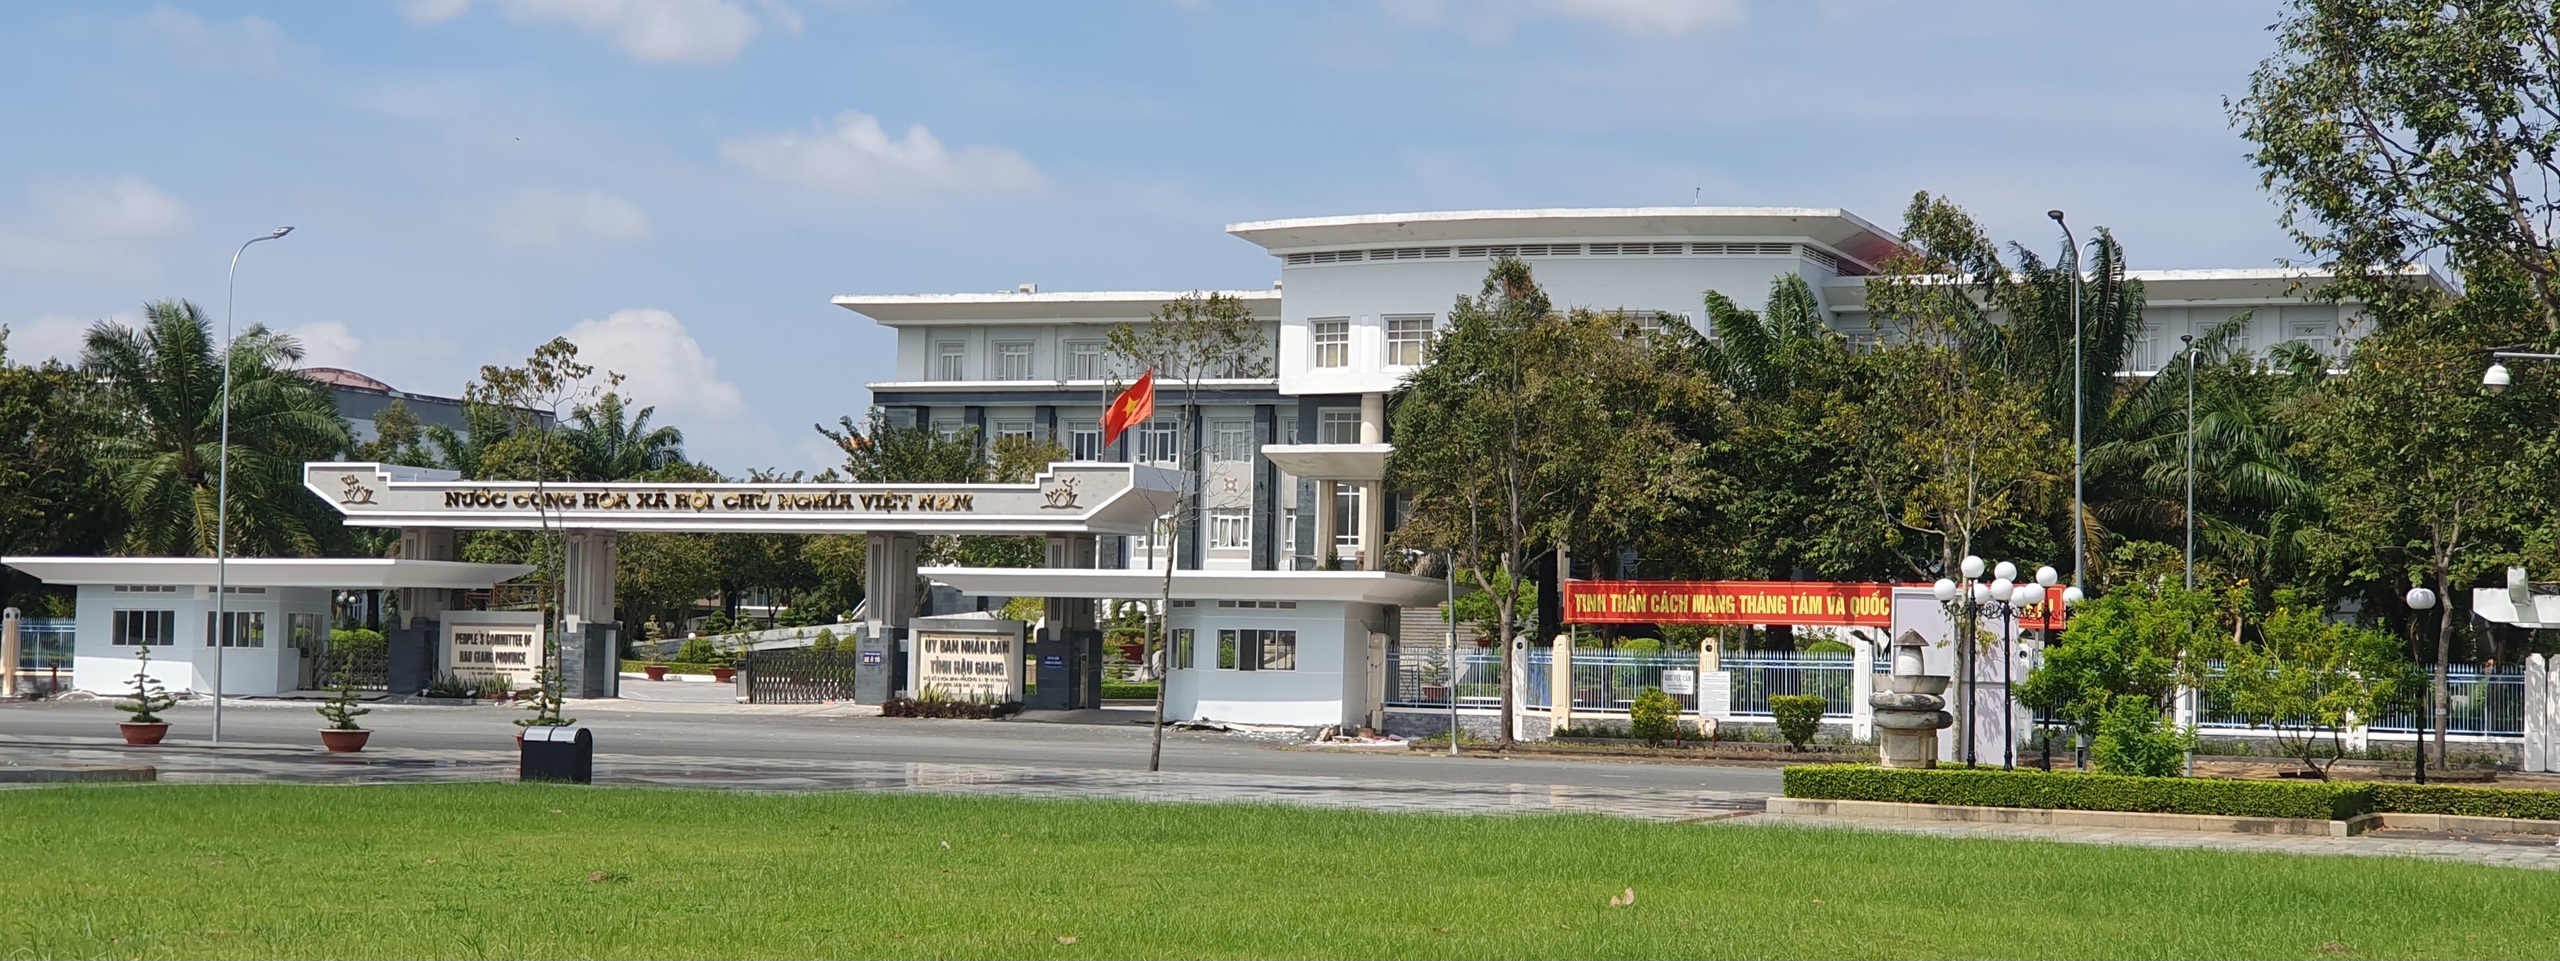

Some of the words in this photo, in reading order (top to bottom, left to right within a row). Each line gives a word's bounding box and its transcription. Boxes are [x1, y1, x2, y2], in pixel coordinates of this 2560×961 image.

[444, 487, 507, 508] NƯỚC
[583, 488, 631, 510] HÒA
[636, 488, 669, 510] XÃ
[674, 488, 715, 513] HỘI
[722, 488, 772, 511] CHỦ
[777, 489, 854, 511] NGHĨA
[859, 489, 913, 514] VIỆT
[918, 493, 974, 511] NAM
[1574, 593, 1606, 613] TINH
[1610, 587, 1646, 613] THẦN
[1650, 590, 1689, 613] CÁCH
[1692, 594, 1735, 618] MẠNG
[1739, 591, 1787, 614] THÁNG
[1791, 591, 1822, 615] TÁM
[1826, 592, 1846, 615] VÀ
[1850, 590, 1890, 618] QUỐC
[486, 633, 523, 647] COMMITTEE
[524, 634, 532, 647] OF
[940, 639, 959, 654] BAN
[961, 636, 987, 654] NHÂN
[990, 637, 1010, 655] DÂN
[495, 651, 526, 665] PROVINCE
[930, 655, 952, 675] TỈNH
[953, 658, 973, 678] HẬU
[975, 661, 1005, 676] GIANG
